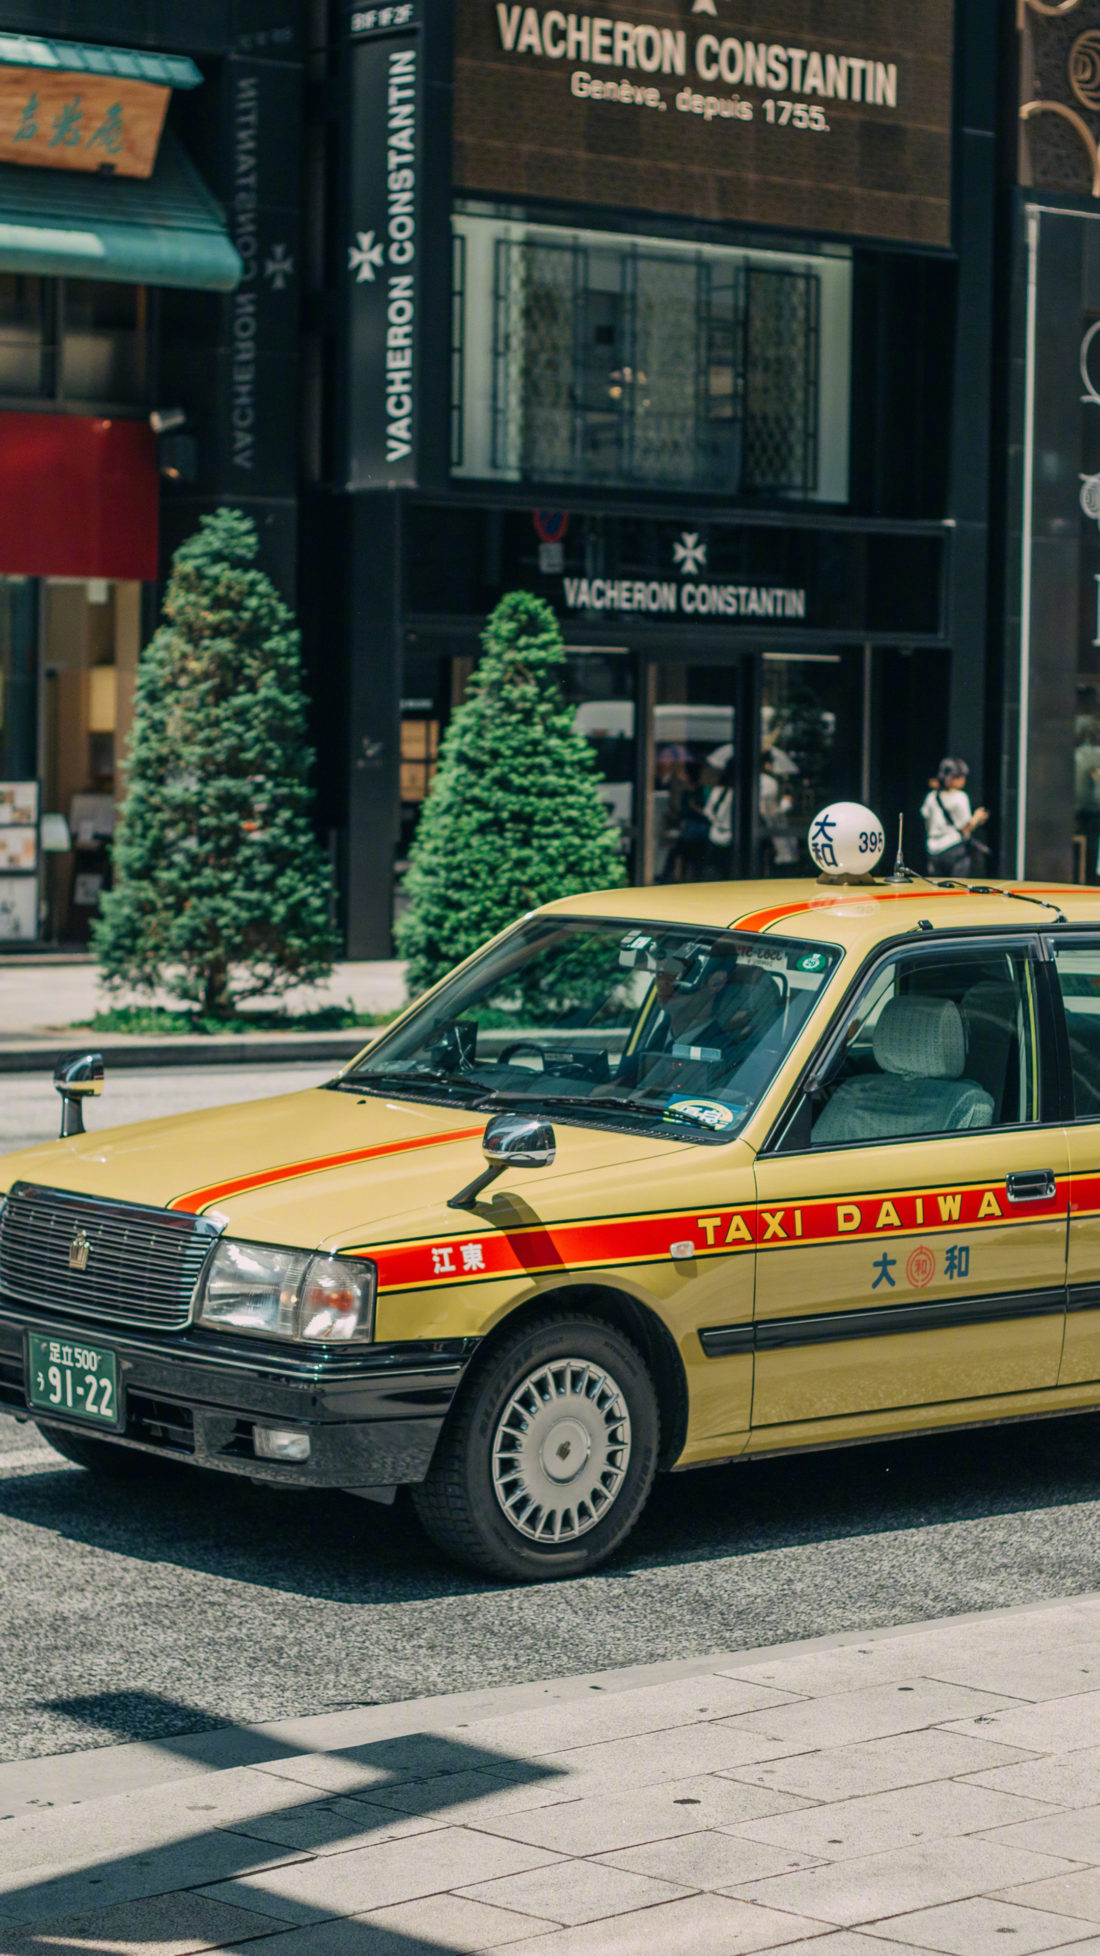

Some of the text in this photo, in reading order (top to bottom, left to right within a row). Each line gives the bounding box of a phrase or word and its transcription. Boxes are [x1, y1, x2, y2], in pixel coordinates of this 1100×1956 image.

[496, 3, 898, 108] VACHERON CONSTANTIN
[570, 71, 830, 132] Genève, depuis 1755.
[385, 50, 416, 462] VACHERON CONSTANTIN
[563, 578, 806, 618] VACHERON CONSTANTIN
[812, 814, 838, 867] 大和
[697, 1191, 1003, 1246] TAXI DAIWA
[431, 1243, 485, 1274] 江東
[48, 1366, 113, 1417] 91-22
